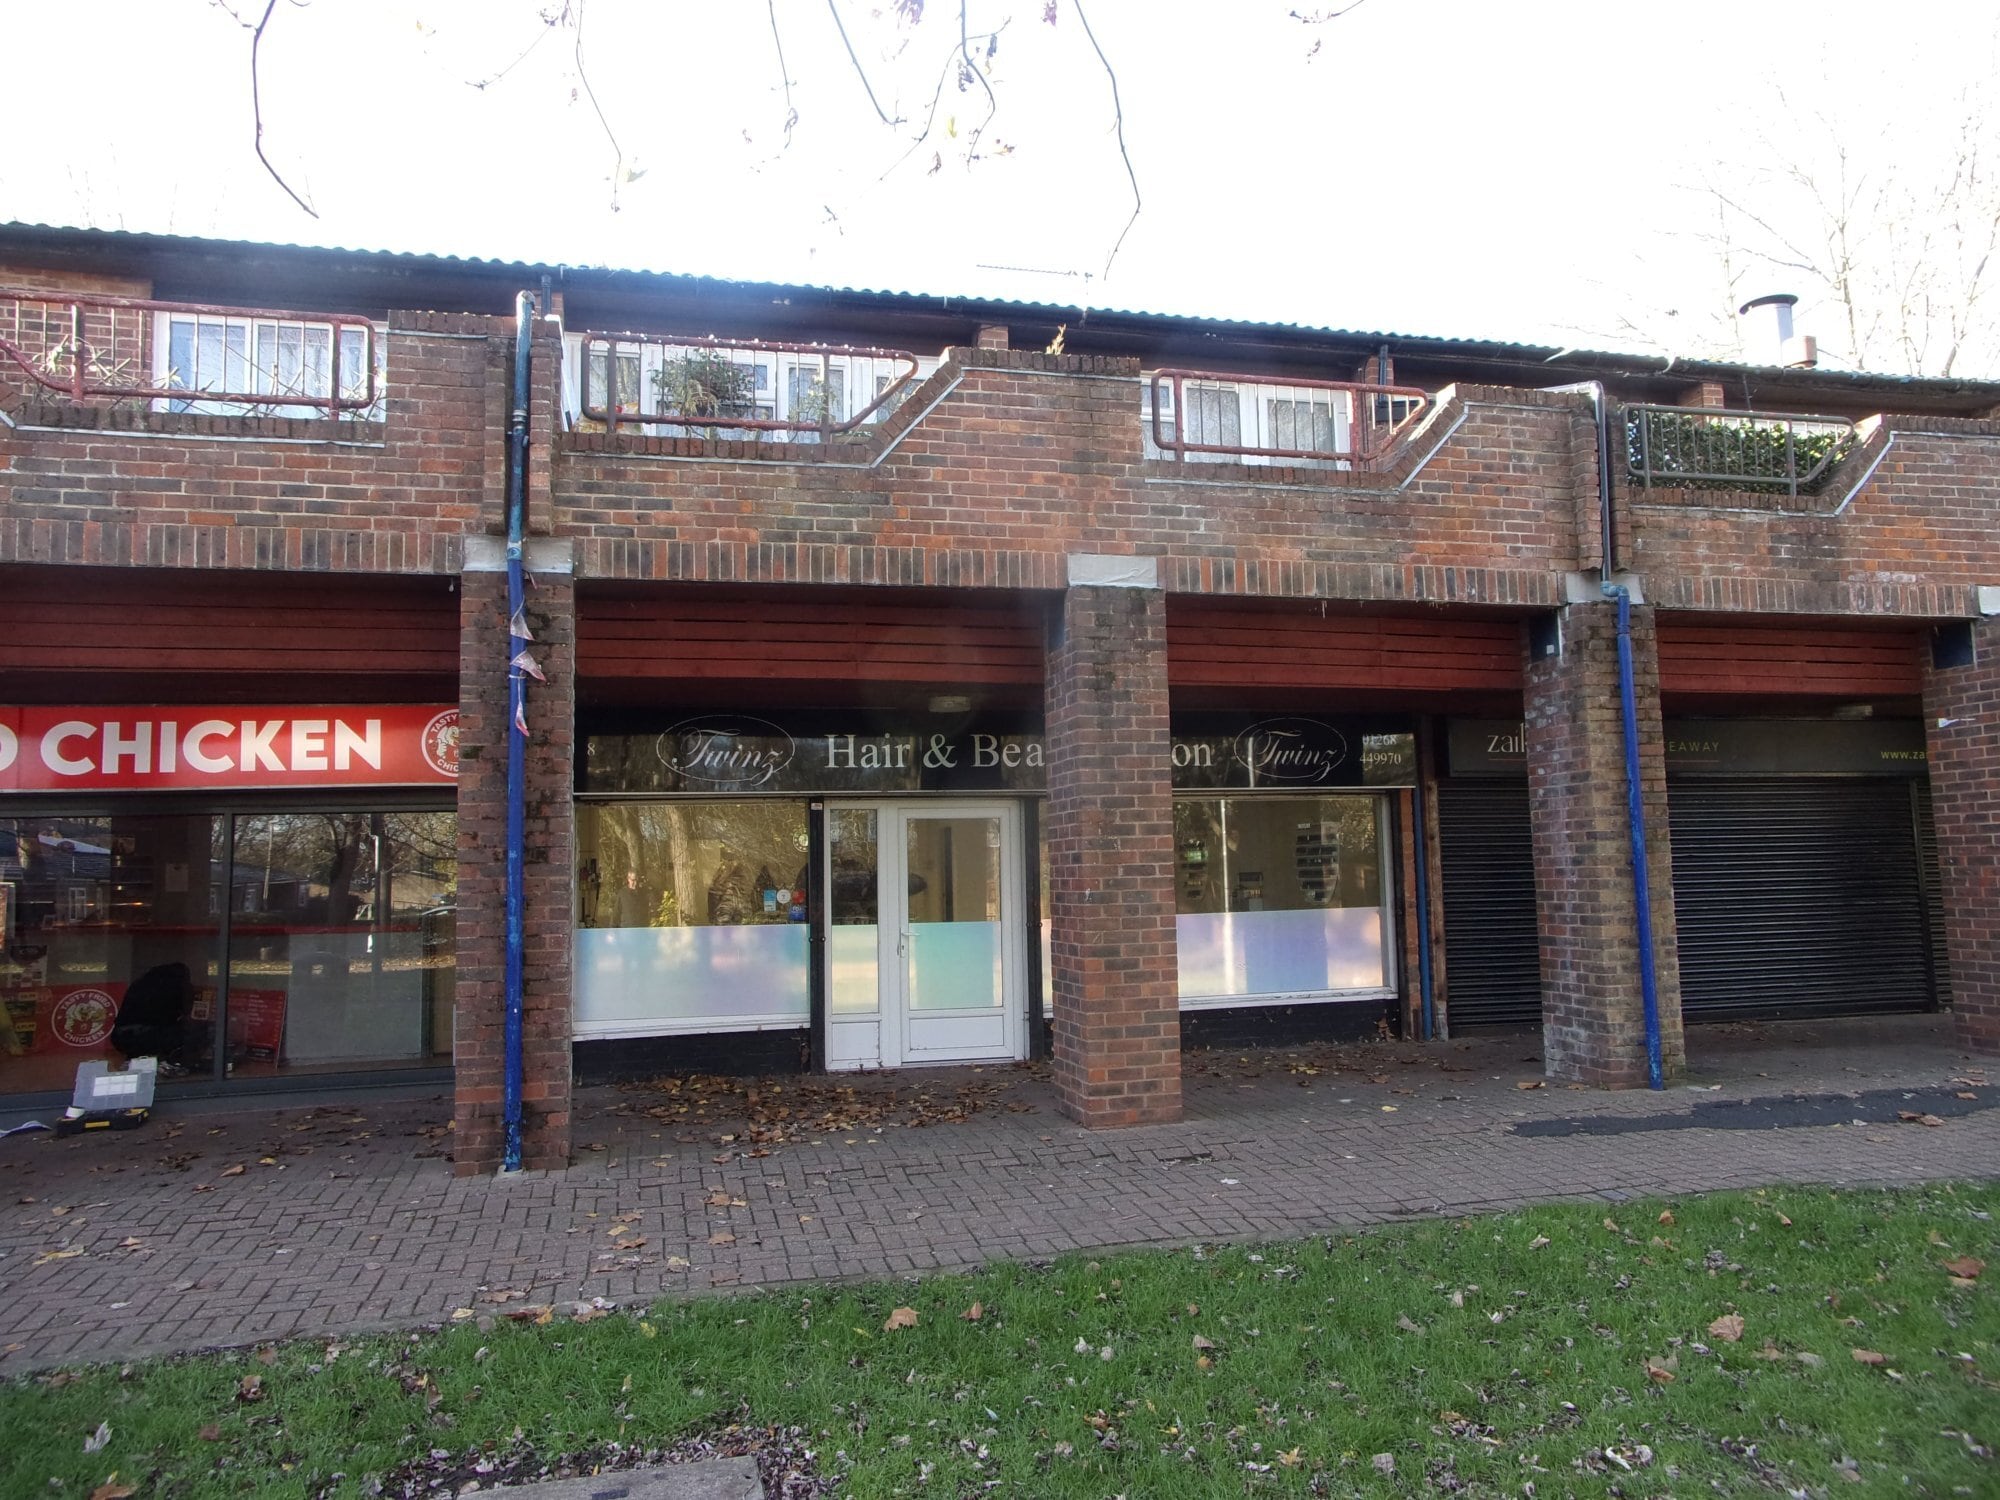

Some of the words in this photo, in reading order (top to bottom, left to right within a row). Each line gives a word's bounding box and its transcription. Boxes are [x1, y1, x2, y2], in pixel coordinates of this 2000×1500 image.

[430, 713, 458, 734] TASTY
[40, 719, 381, 776] CHICKEN
[1362, 733, 1398, 746] 01268
[587, 742, 596, 757] 8
[672, 727, 784, 787] Twinz
[823, 732, 912, 769] Hair
[922, 733, 958, 769] &
[969, 733, 1046, 768] Bea
[1171, 742, 1217, 768] on
[1252, 728, 1338, 782] Twinz
[1359, 752, 1402, 766] 449970
[61, 992, 86, 1010] TASTY
[64, 1030, 105, 1043] CHICKEN
